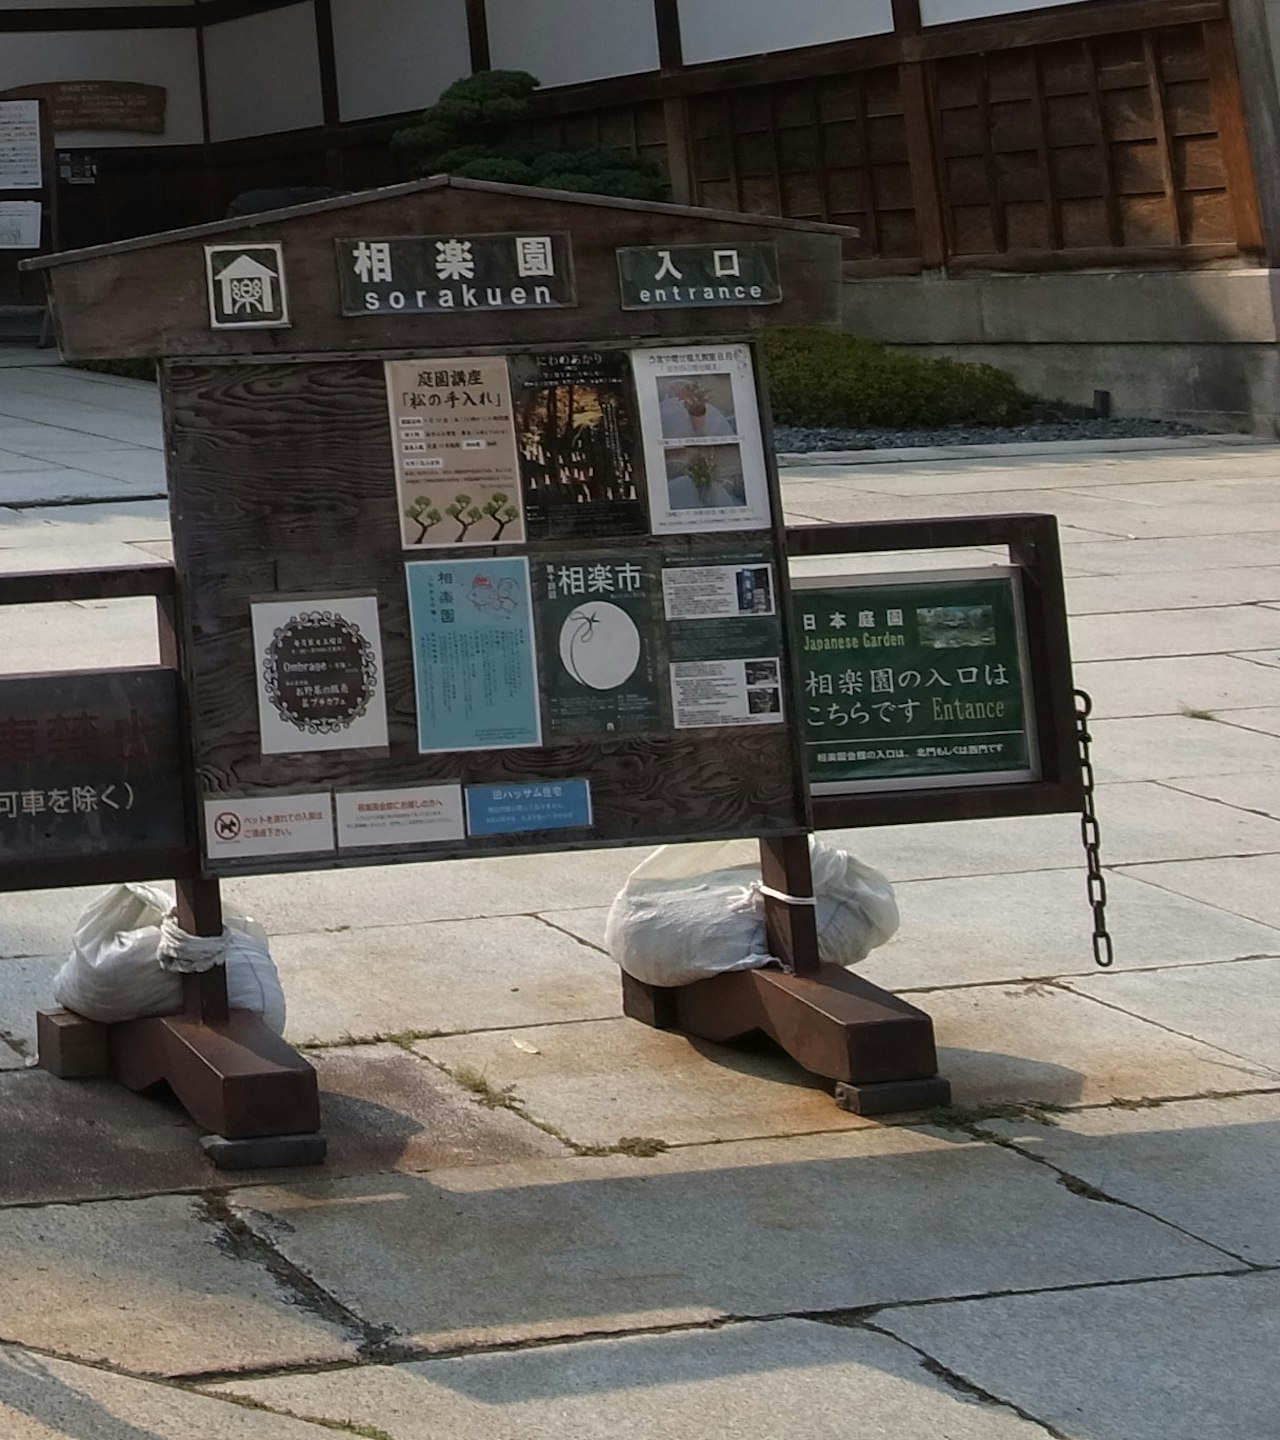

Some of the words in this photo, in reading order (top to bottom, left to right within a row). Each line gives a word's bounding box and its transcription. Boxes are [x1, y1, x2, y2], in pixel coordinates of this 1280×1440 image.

[352, 236, 555, 283] 相楽園
[654, 249, 740, 281] 入口
[364, 282, 551, 310] sorakuen
[639, 285, 762, 302] entrance
[417, 369, 484, 388] 庭園講座
[557, 562, 642, 596] 相楽市
[802, 608, 904, 631] 日本庭園
[803, 634, 859, 652] Japanese
[862, 632, 906, 647] Garden
[805, 663, 1010, 698] 相楽園の入口は
[806, 698, 921, 727] こちらです
[932, 696, 1005, 721] Entance
